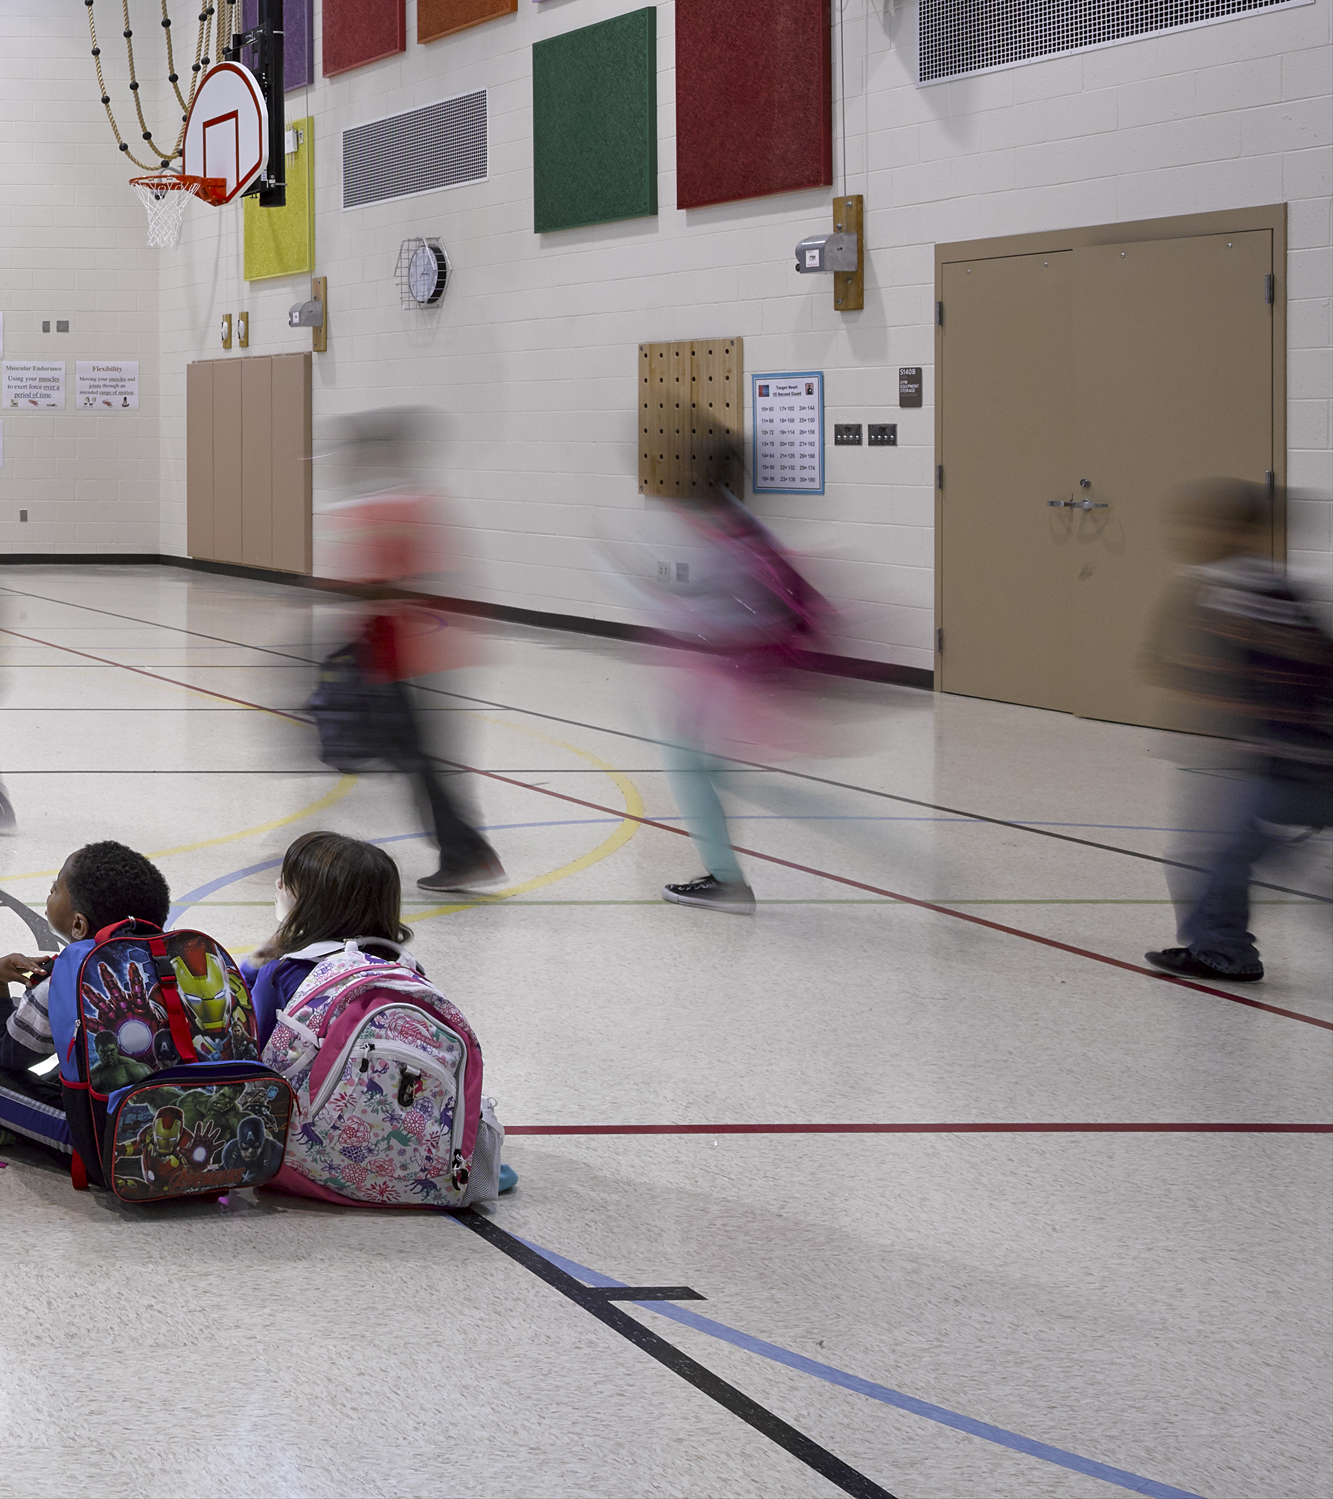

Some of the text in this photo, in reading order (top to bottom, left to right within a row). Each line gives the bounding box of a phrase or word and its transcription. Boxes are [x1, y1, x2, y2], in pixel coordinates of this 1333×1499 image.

[161, 1042, 169, 1052] A
[247, 1131, 255, 1141] A
[167, 1167, 246, 1194] AVENGERS
